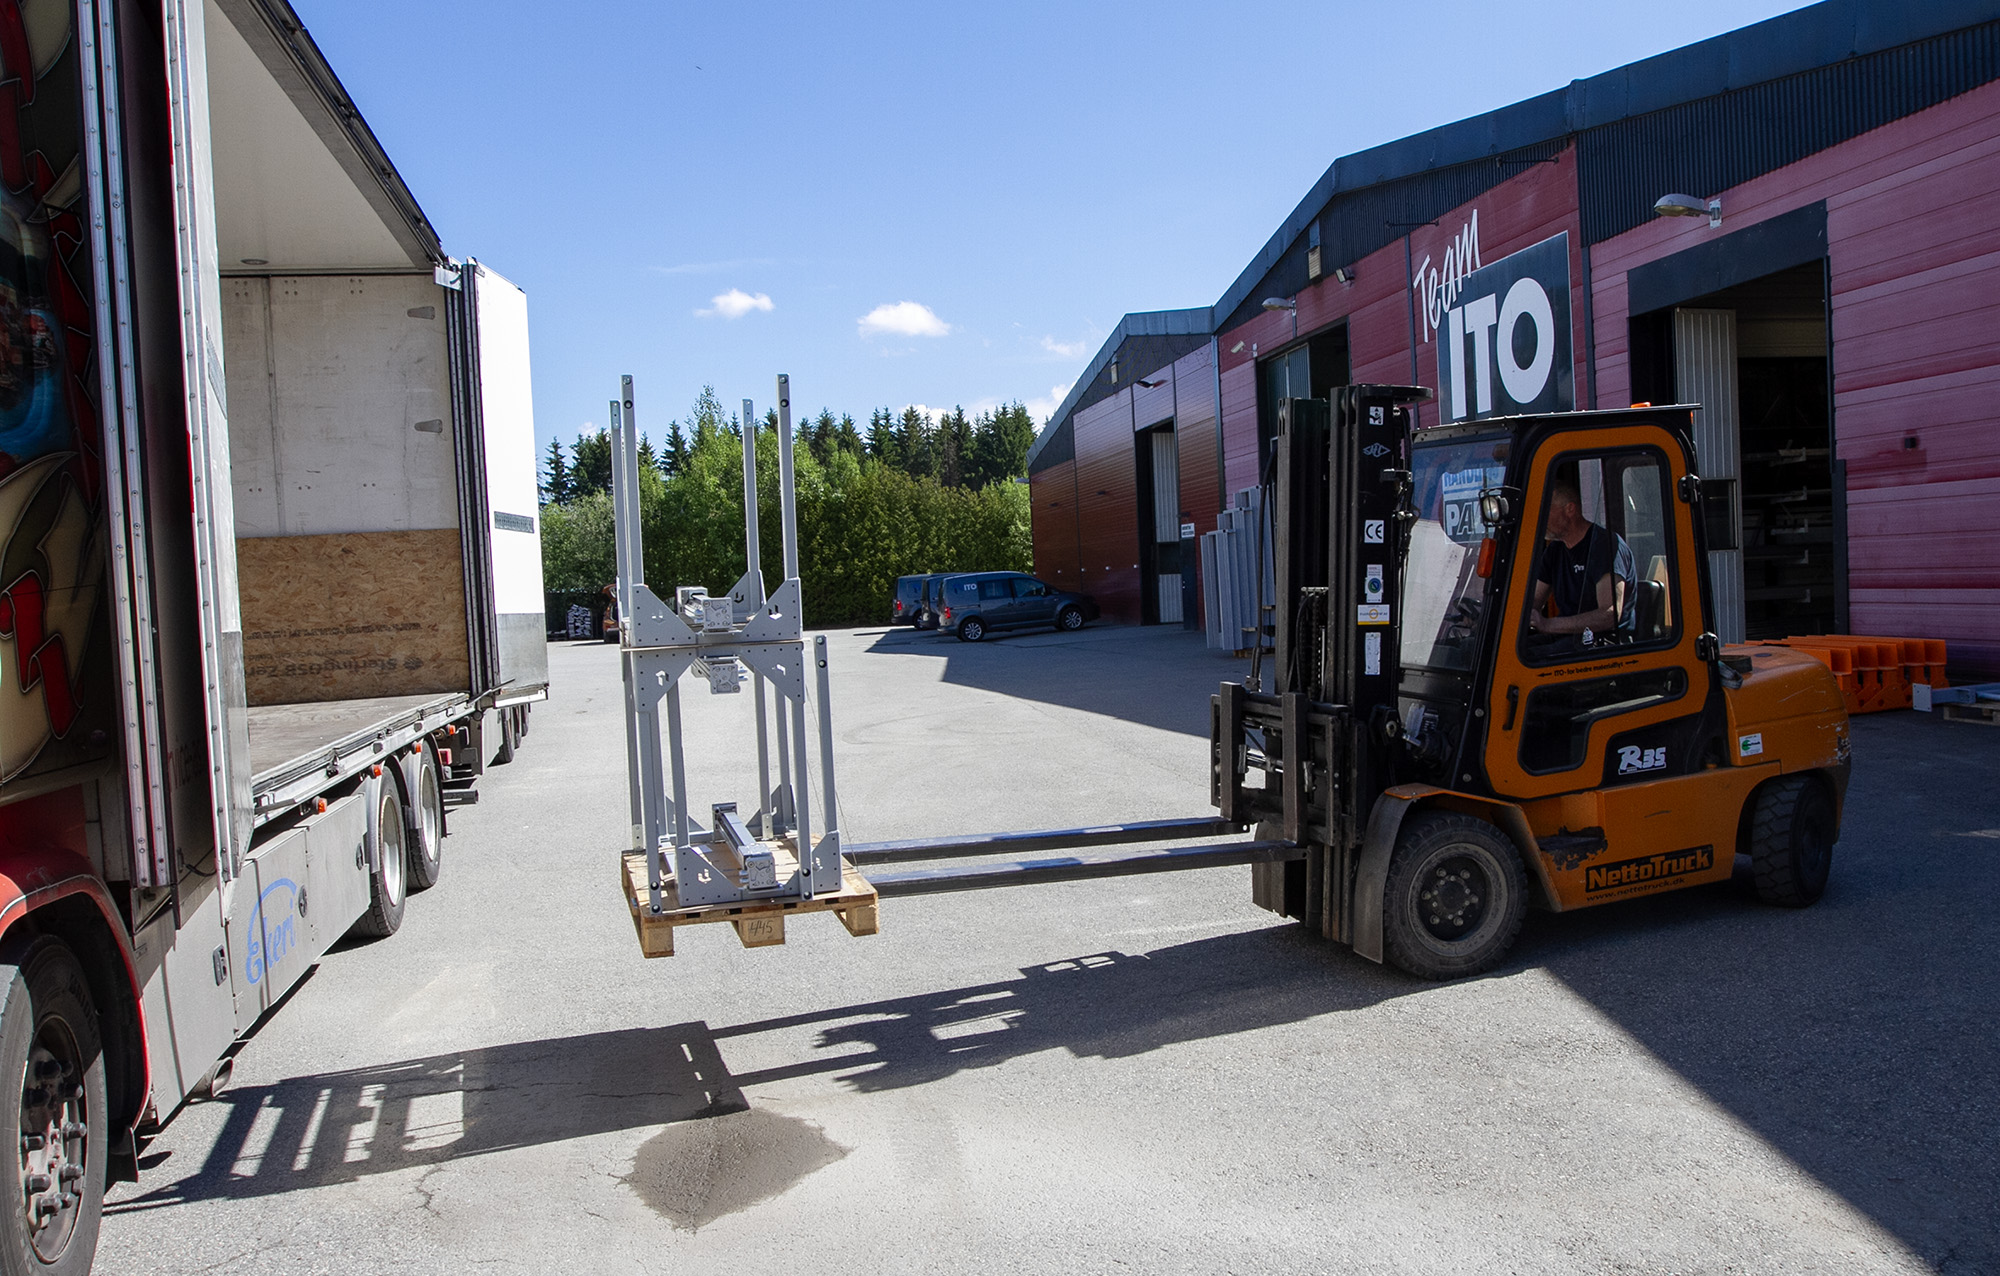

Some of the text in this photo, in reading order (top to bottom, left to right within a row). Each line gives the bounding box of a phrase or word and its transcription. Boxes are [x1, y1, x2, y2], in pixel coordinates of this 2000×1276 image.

[1448, 277, 1555, 420] ITO
[1365, 523, 1383, 540] CE
[963, 583, 978, 592] ITO
[1588, 849, 1710, 890] NettoTruck
[1586, 876, 1686, 902] www.nettotruck.dk
